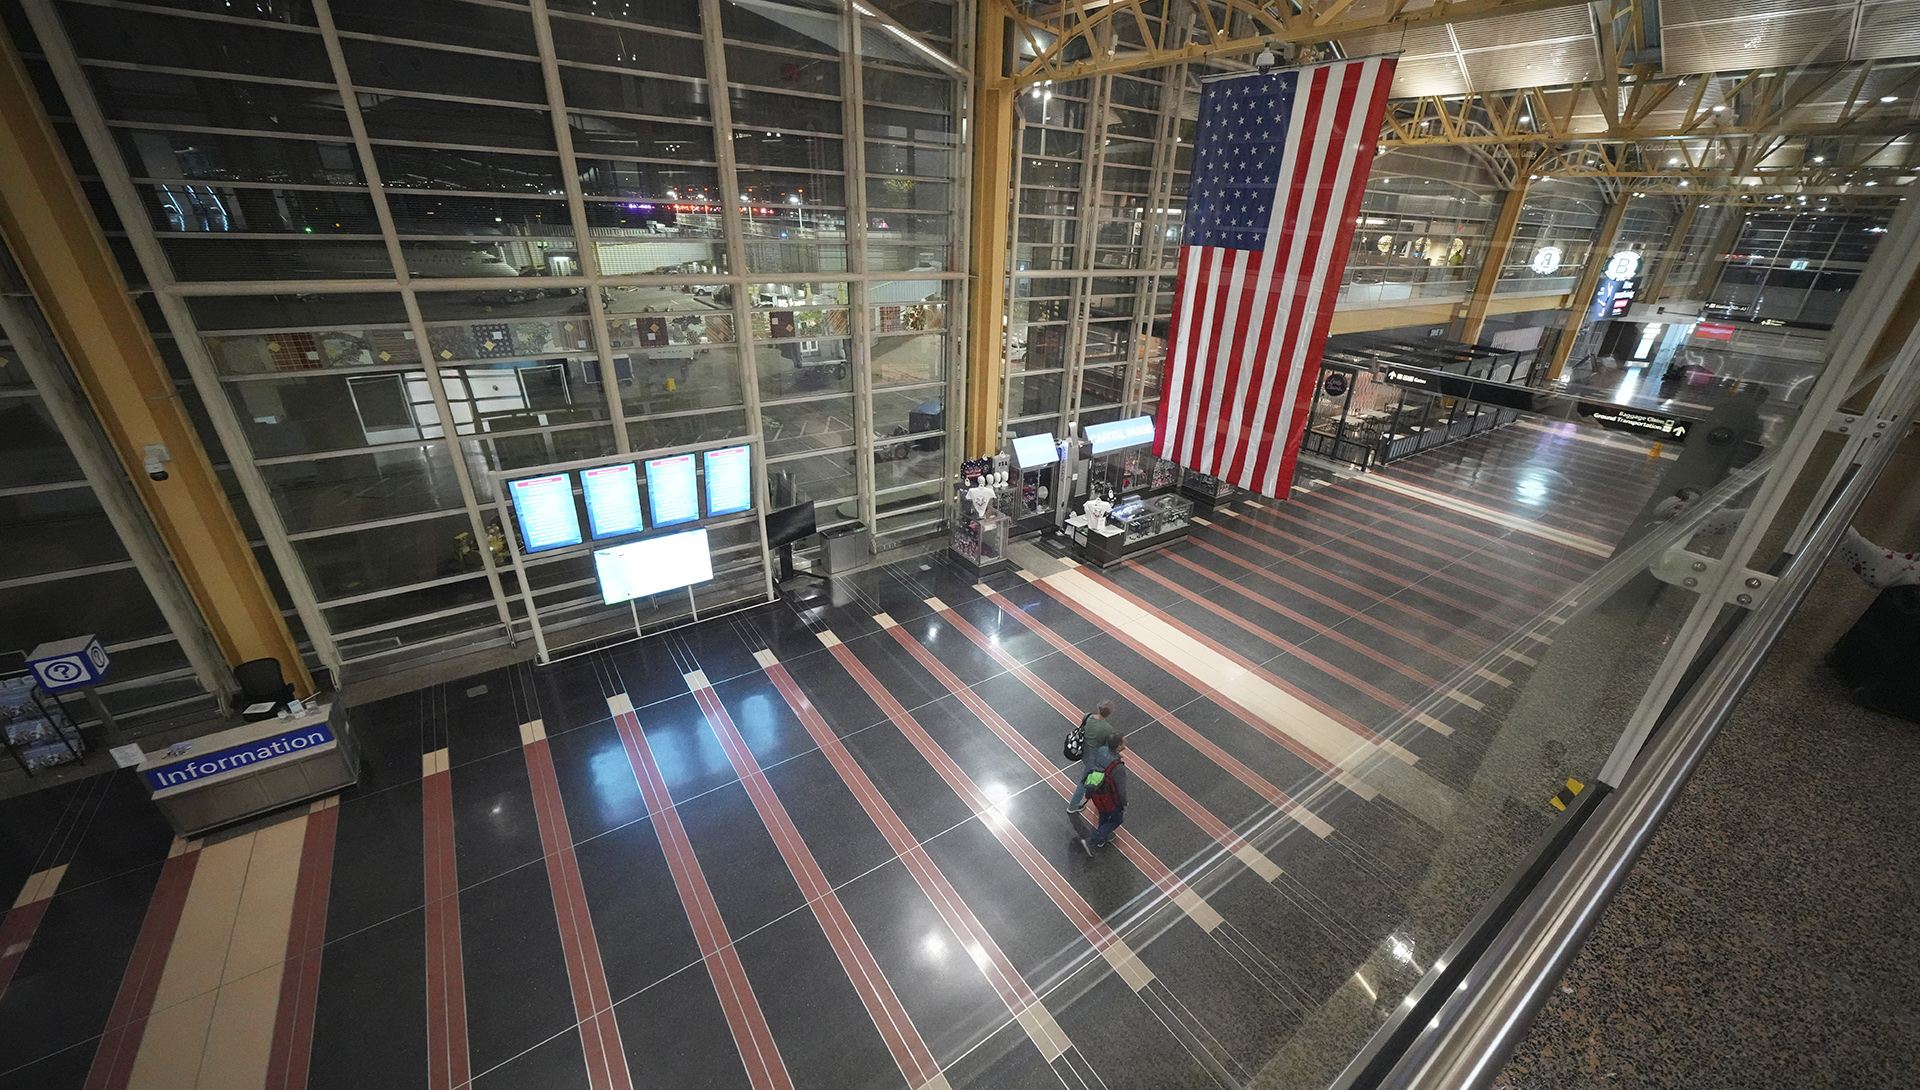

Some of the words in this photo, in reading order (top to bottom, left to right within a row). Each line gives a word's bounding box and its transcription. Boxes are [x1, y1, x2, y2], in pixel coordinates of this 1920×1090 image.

[1593, 412, 1617, 422] Ground
[1617, 417, 1663, 431] Transportation
[1618, 411, 1647, 421] Baggage
[1646, 416, 1665, 424] Claim
[1089, 429, 1127, 443] CAPITAL
[1125, 423, 1154, 437] IMAGE
[156, 731, 325, 786] Information
